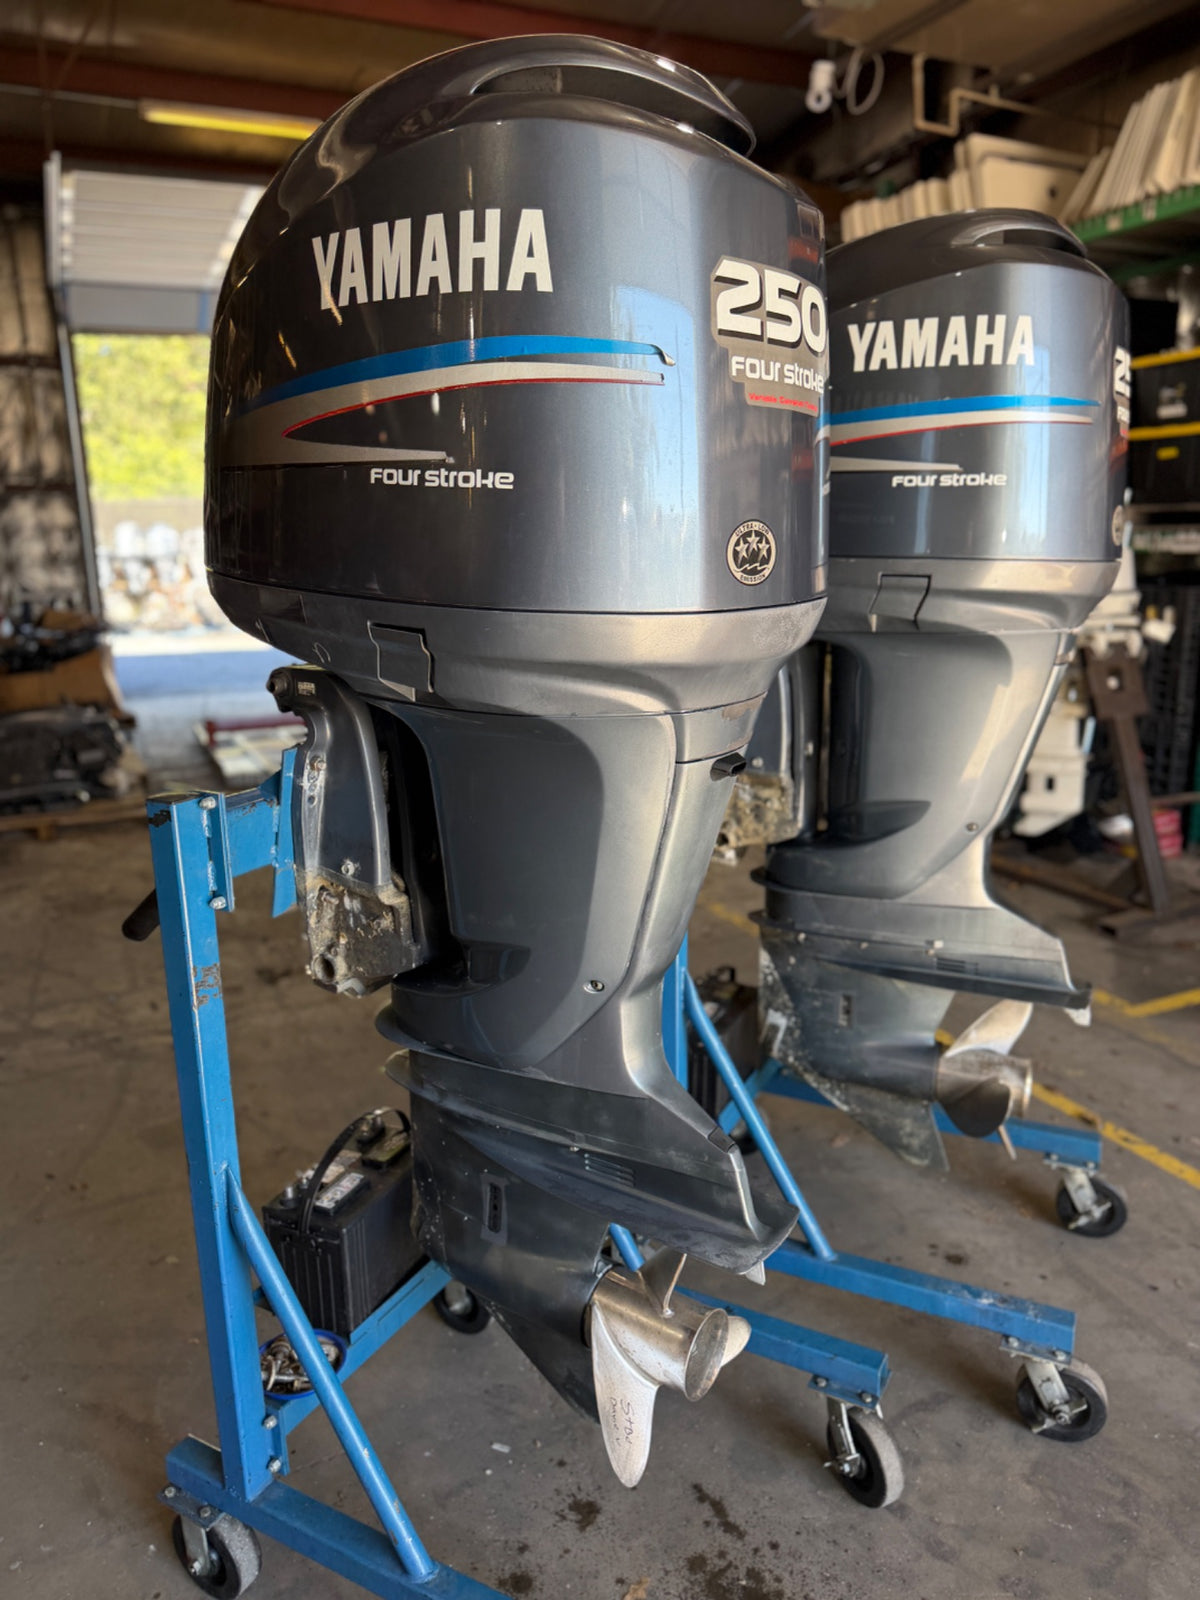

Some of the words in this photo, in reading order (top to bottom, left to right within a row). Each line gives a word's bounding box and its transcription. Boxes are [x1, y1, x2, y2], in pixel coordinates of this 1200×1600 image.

[312, 208, 553, 310] YAMAHA
[714, 259, 827, 358] 250
[847, 314, 1036, 373] YAMAHA
